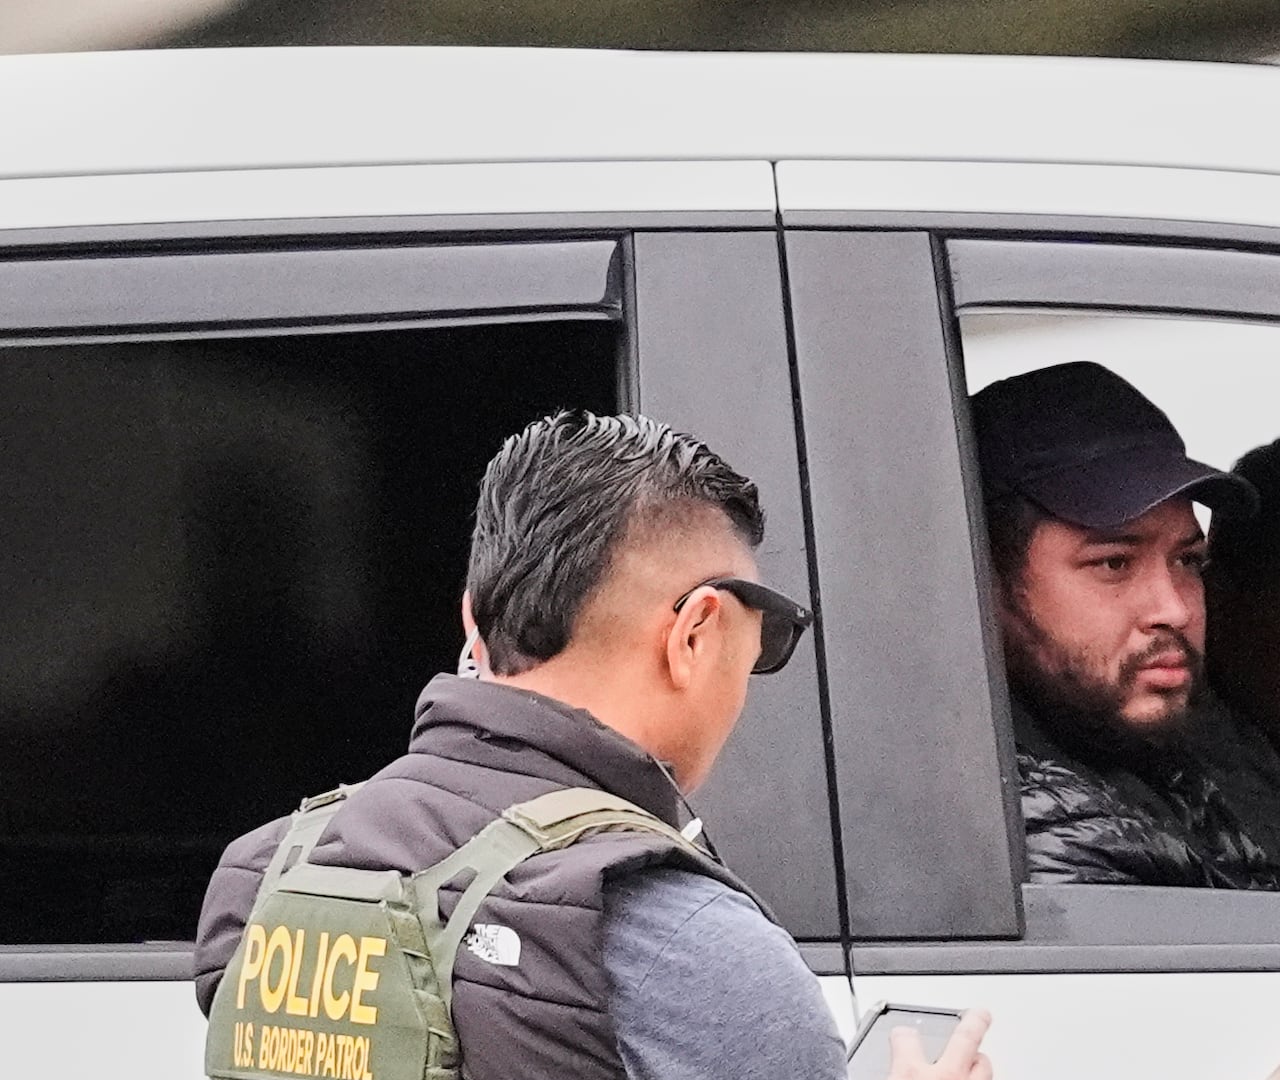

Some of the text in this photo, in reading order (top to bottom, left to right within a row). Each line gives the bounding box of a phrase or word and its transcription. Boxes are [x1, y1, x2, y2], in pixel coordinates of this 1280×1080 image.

[236, 924, 387, 1025] POLICE
[233, 1022, 255, 1067] U.S.
[258, 1025, 314, 1076] BORDER
